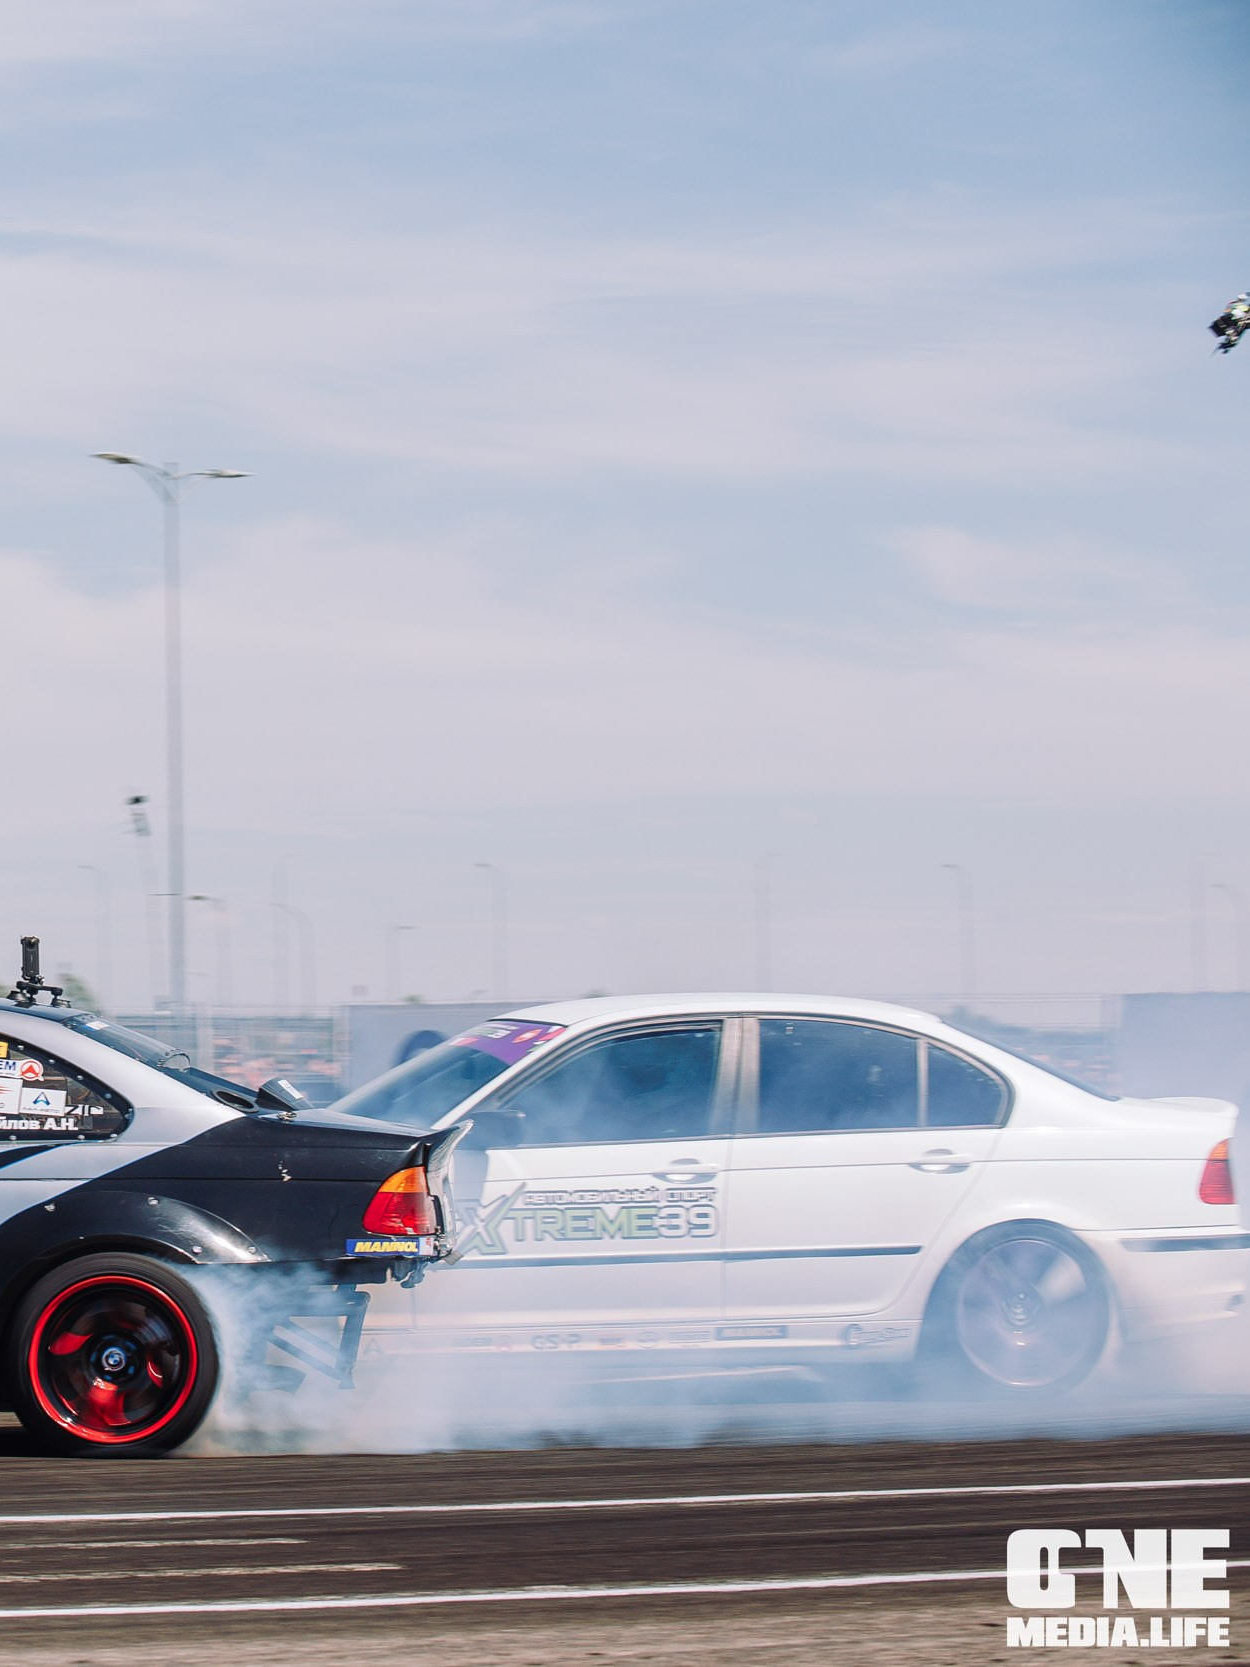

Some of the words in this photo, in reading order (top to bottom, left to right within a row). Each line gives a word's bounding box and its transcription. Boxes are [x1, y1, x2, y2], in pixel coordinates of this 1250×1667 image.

[43, 1117, 79, 1131] А.Н.
[524, 1186, 661, 1205] АВТОМОБИЛЬНЫЙ
[665, 1187, 717, 1203] СПОРТ
[453, 1182, 719, 1256] XTREME39
[354, 1241, 419, 1253] MANNOL
